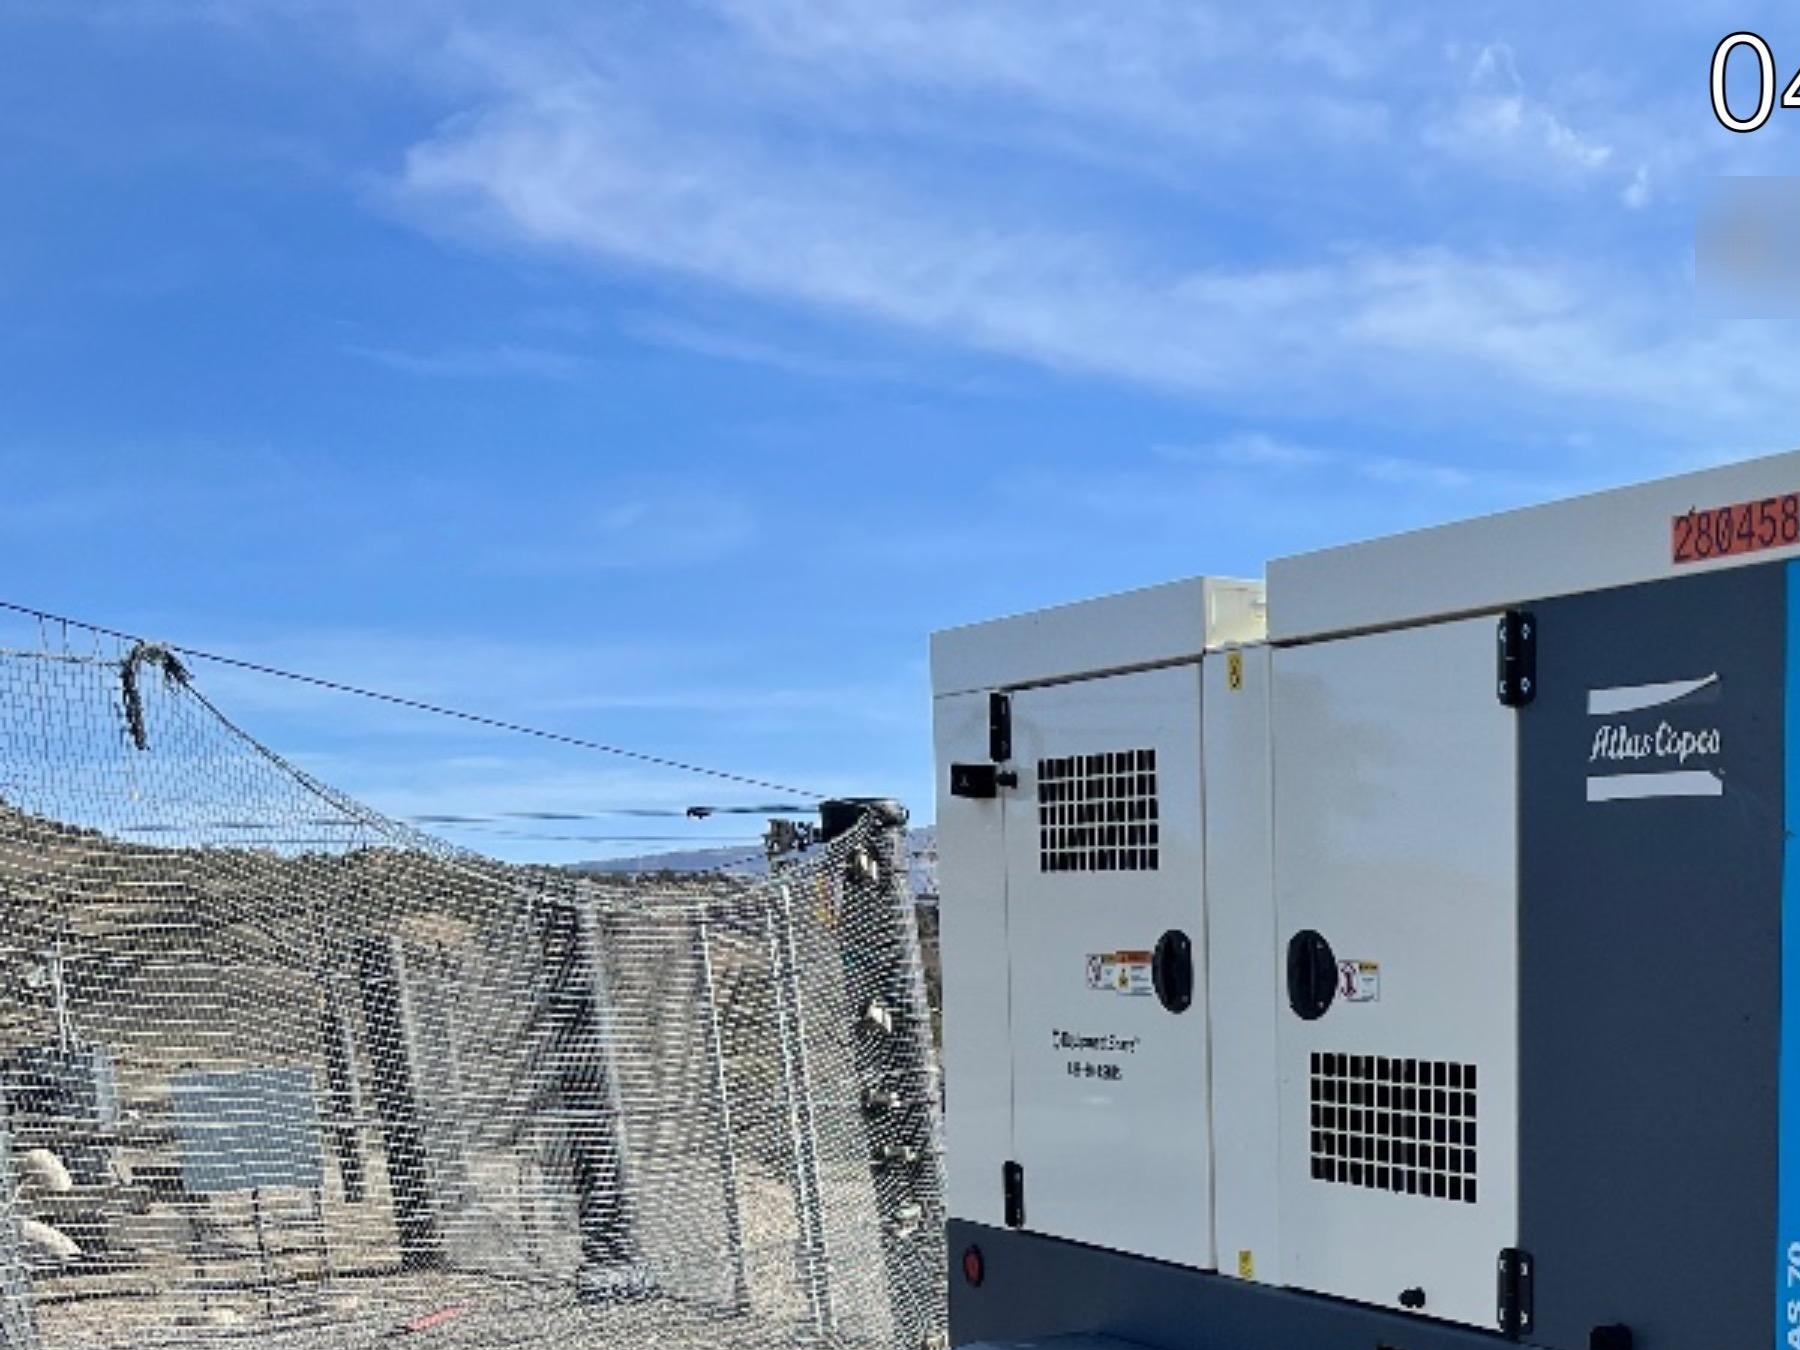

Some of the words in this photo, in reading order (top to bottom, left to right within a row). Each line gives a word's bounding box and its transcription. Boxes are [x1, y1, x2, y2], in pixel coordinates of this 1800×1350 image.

[1673, 494, 1800, 563] 280458
[1588, 725, 1653, 762] Atlas
[1655, 720, 1721, 765] Copco
